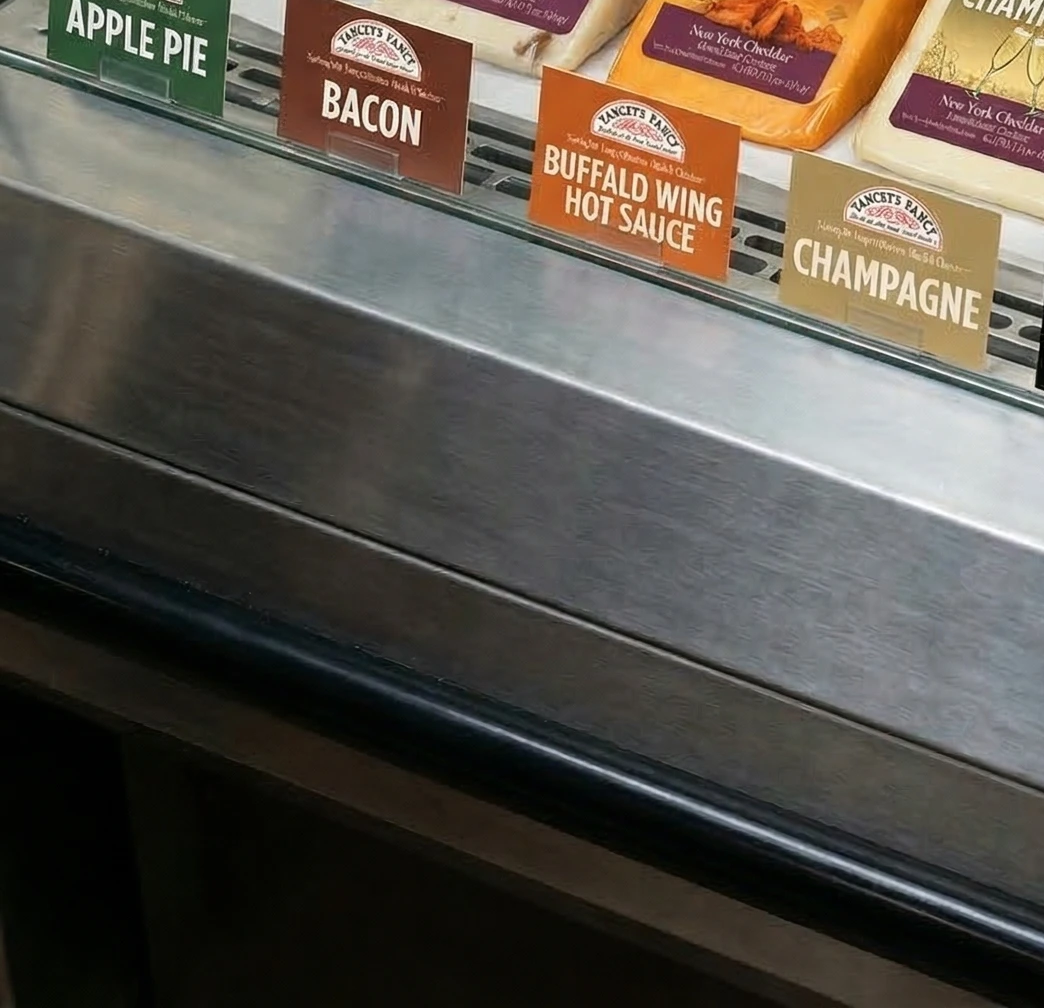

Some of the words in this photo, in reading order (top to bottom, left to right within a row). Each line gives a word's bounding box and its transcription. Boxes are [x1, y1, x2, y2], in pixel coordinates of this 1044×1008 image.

[164, 28, 208, 77] PIE
[321, 79, 422, 146] BACON
[966, 101, 994, 119] York
[565, 185, 614, 225] HOT
[618, 204, 696, 254] SAUCE
[656, 179, 722, 227] WING
[793, 238, 982, 330] CHAMPAGNE
